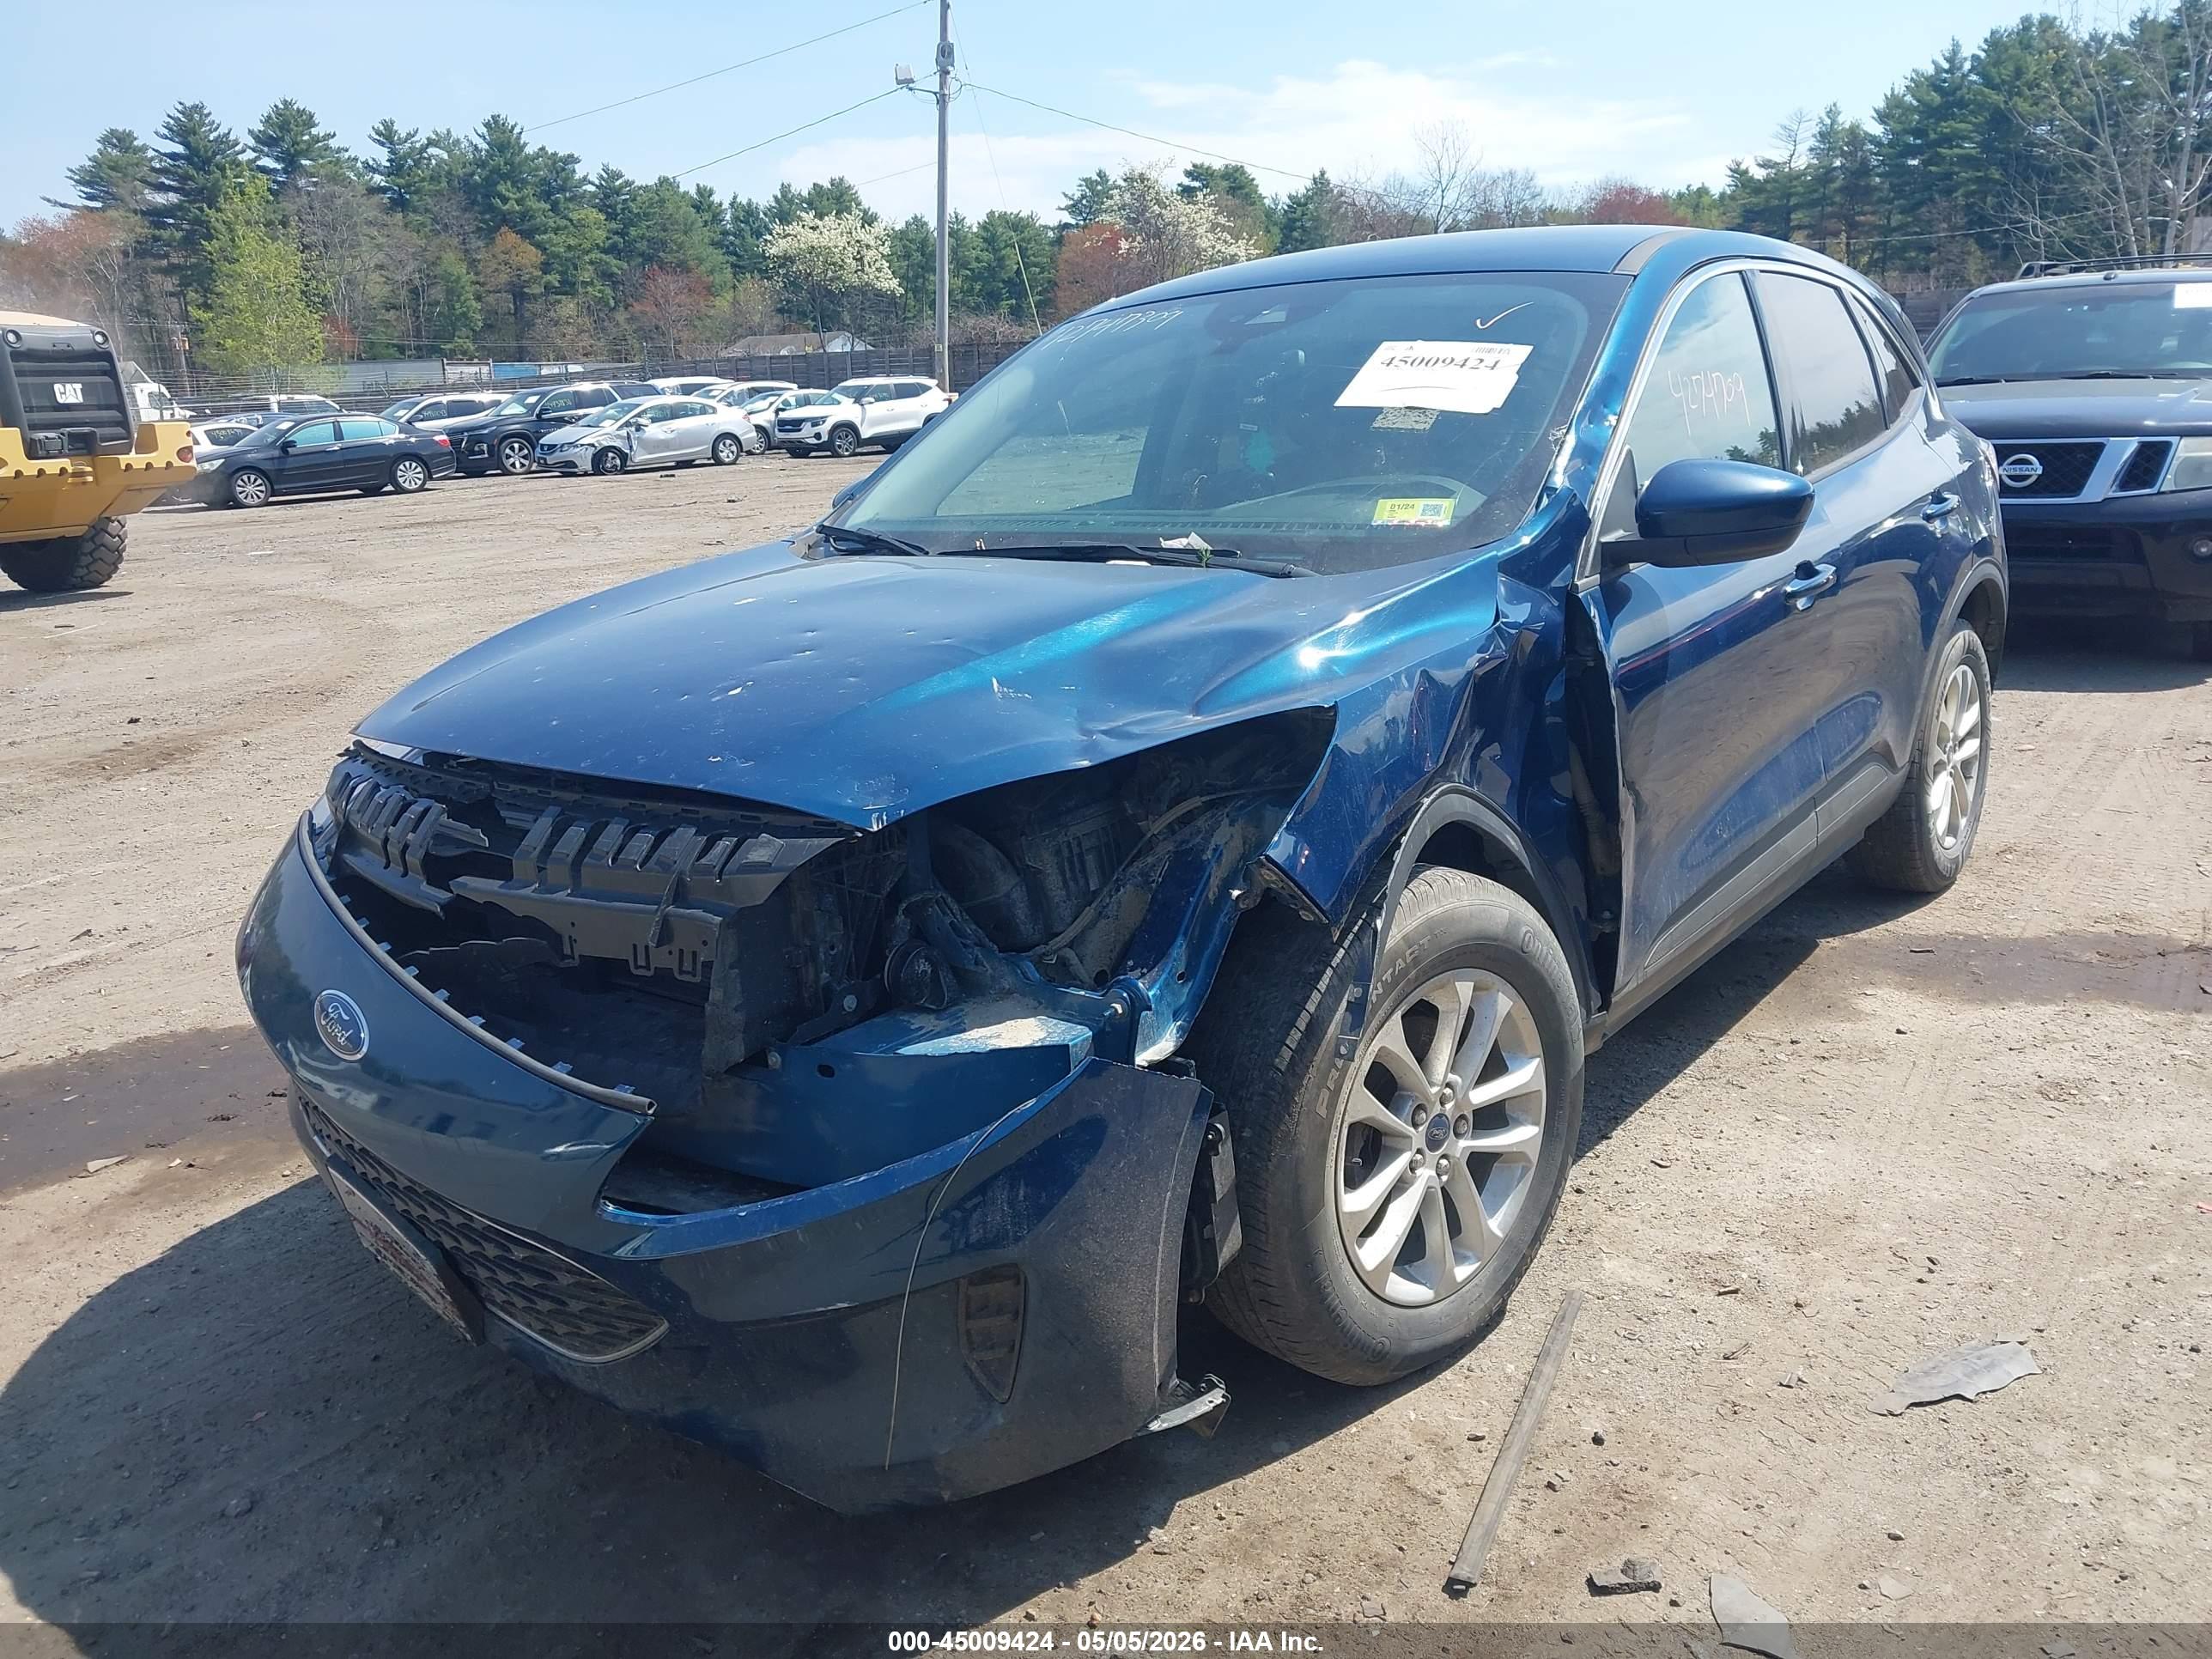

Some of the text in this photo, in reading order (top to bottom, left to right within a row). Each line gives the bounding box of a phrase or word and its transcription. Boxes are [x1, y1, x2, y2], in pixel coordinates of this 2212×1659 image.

[1381, 356, 1501, 370] 45009424
[53, 383, 83, 404] CAT
[320, 1002, 354, 1046] Ford
